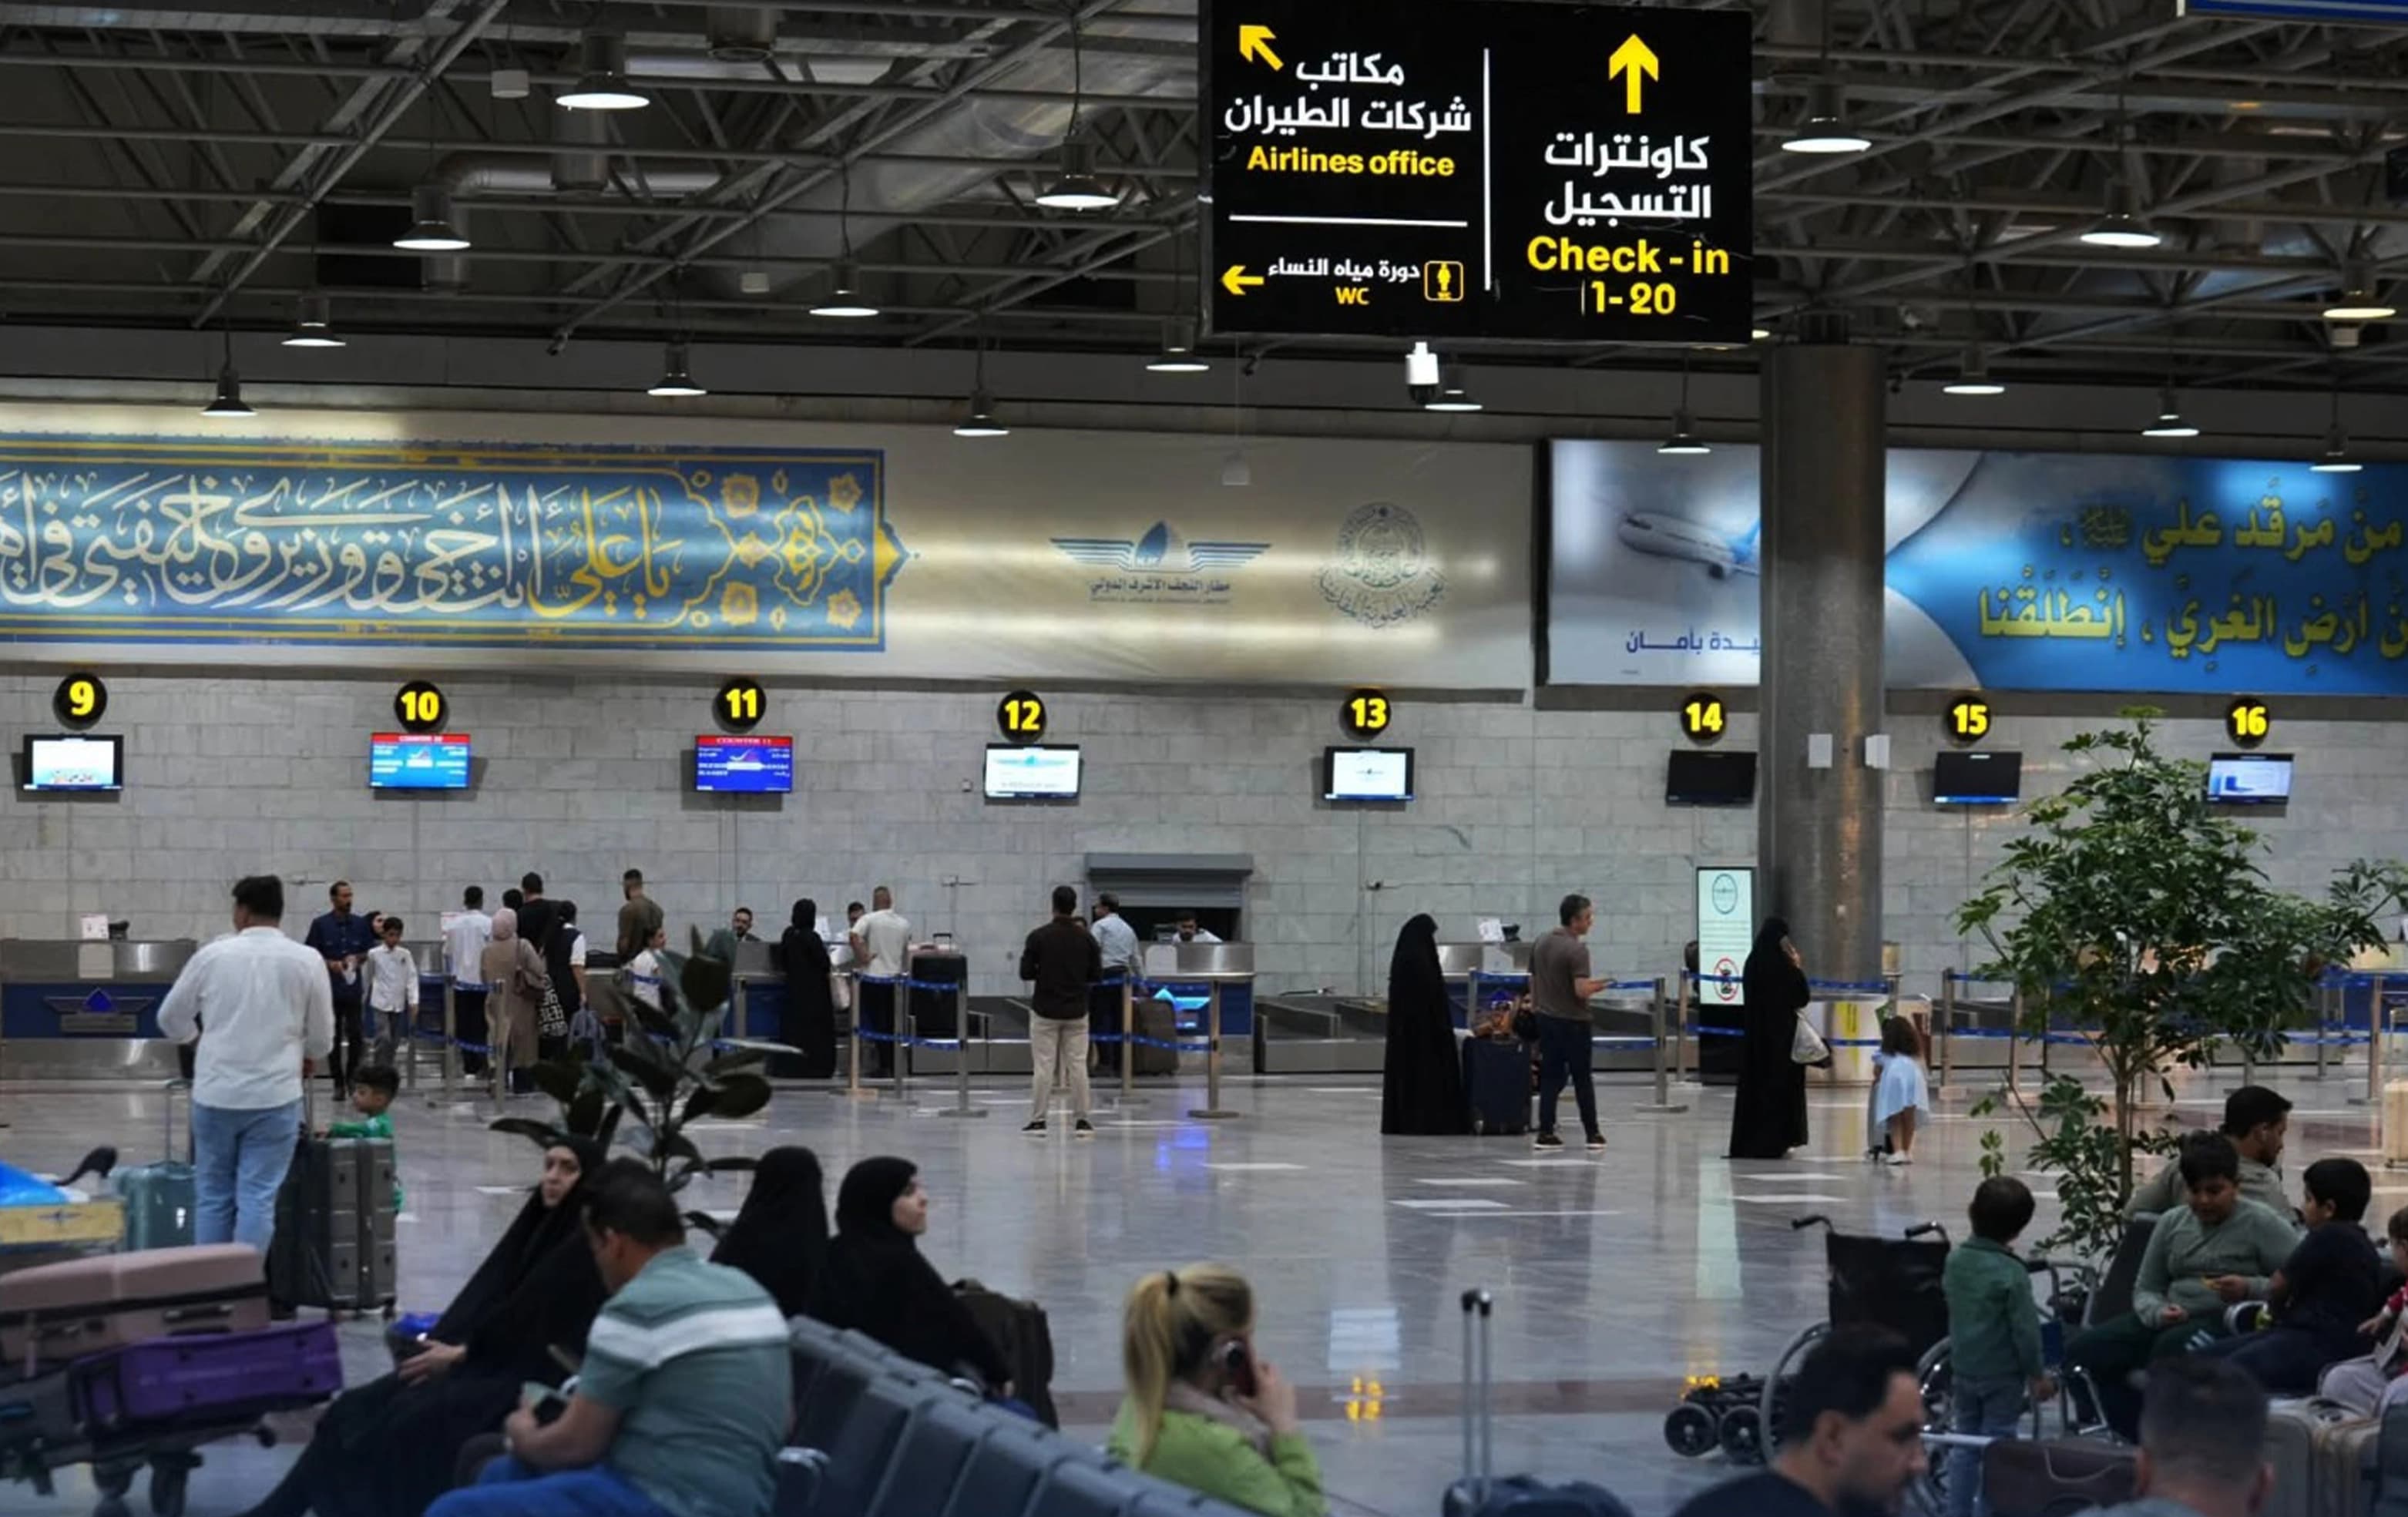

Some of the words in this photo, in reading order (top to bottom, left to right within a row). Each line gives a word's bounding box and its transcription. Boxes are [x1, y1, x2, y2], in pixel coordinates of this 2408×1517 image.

[1295, 52, 1405, 91] مكاتب
[1224, 95, 1350, 136] الطيران
[1361, 96, 1472, 139] شركات
[1247, 146, 1364, 174] Airlines
[1369, 149, 1455, 176] office
[1544, 132, 1710, 178] كاونترات
[1544, 180, 1711, 227] التسجيل
[1268, 257, 1328, 276] النساء
[1333, 258, 1374, 282] مياه
[1527, 236, 1661, 273] Check
[1693, 240, 1728, 274] in
[1378, 259, 1421, 283] دورة
[1335, 287, 1369, 305] WC
[1591, 280, 1676, 314] 1-20
[2143, 497, 2222, 566] علي
[1709, 631, 1762, 656] يدة
[69, 681, 95, 716] 9
[401, 691, 439, 721] 10
[726, 688, 757, 718] 11
[1351, 698, 1386, 728] 13
[1005, 700, 1040, 730] 12
[1686, 702, 1723, 732] 14
[1953, 703, 1987, 734] 15
[2232, 706, 2267, 736] 16
